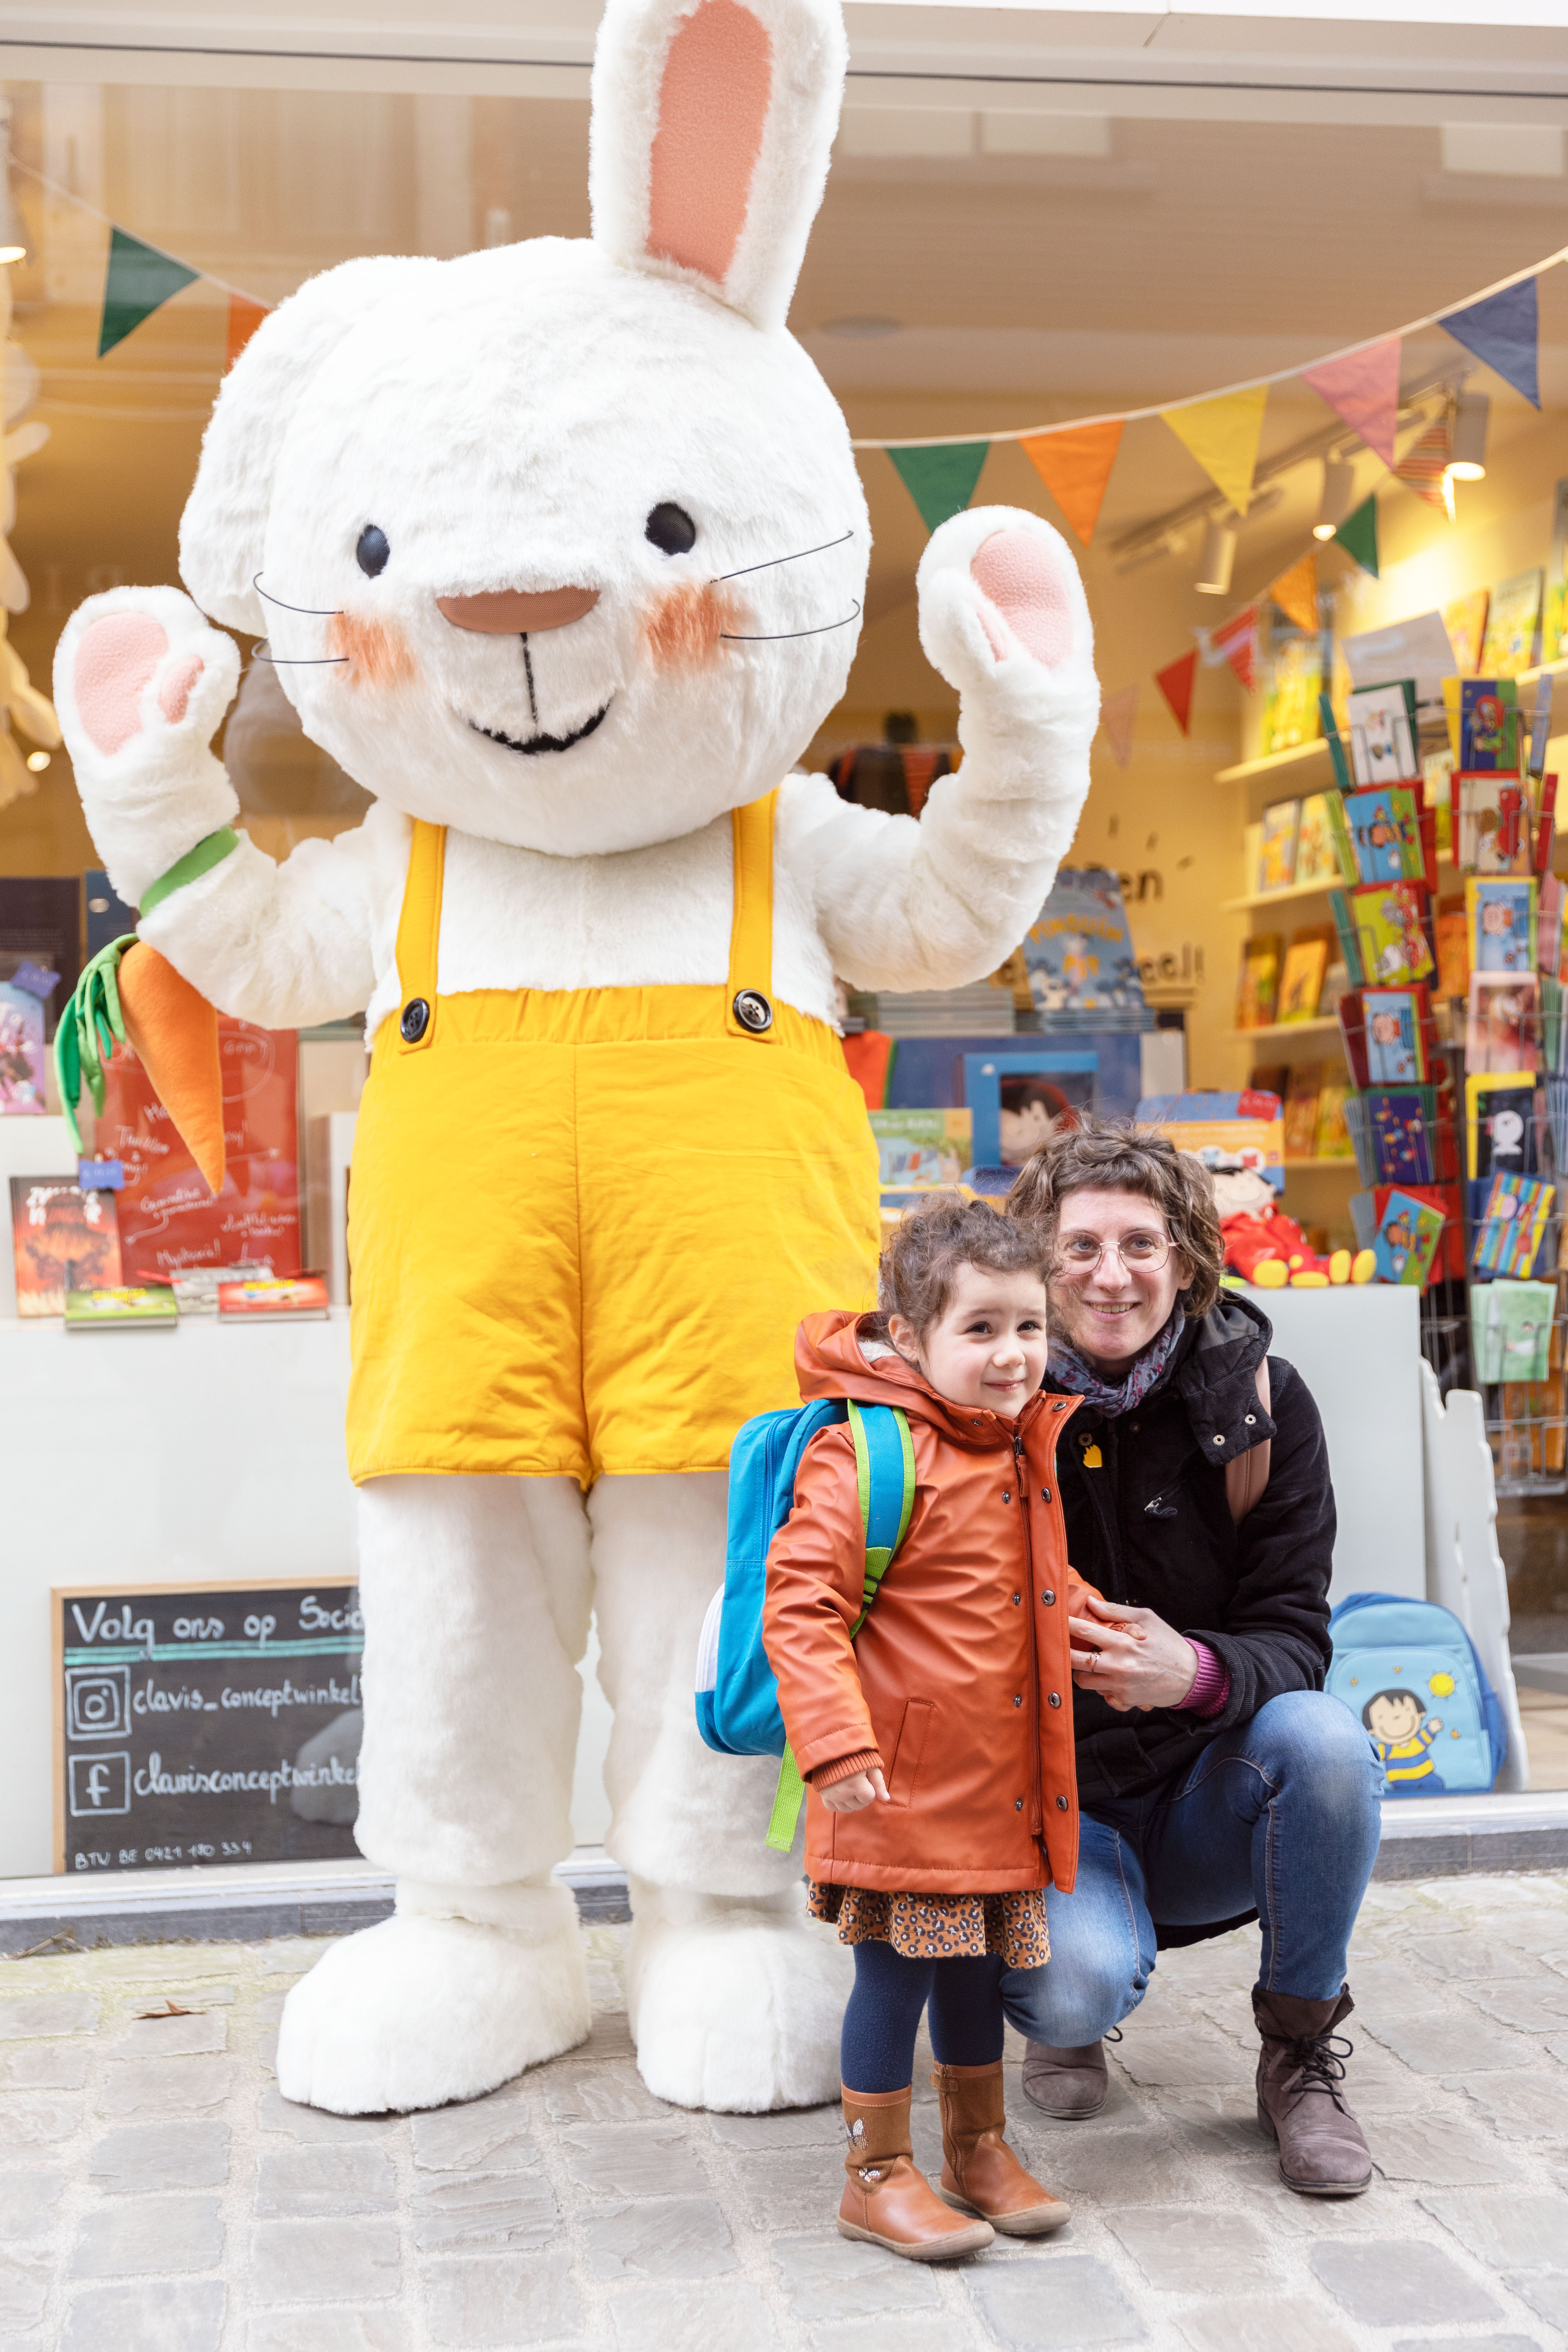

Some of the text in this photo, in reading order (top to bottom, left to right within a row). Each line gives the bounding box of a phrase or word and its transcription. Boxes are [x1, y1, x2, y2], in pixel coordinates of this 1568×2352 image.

[71, 1595, 365, 1661] Volg ons op Socia
[86, 1763, 110, 1807] f
[119, 1849, 138, 1864] BE
[145, 1845, 183, 1862] 0421
